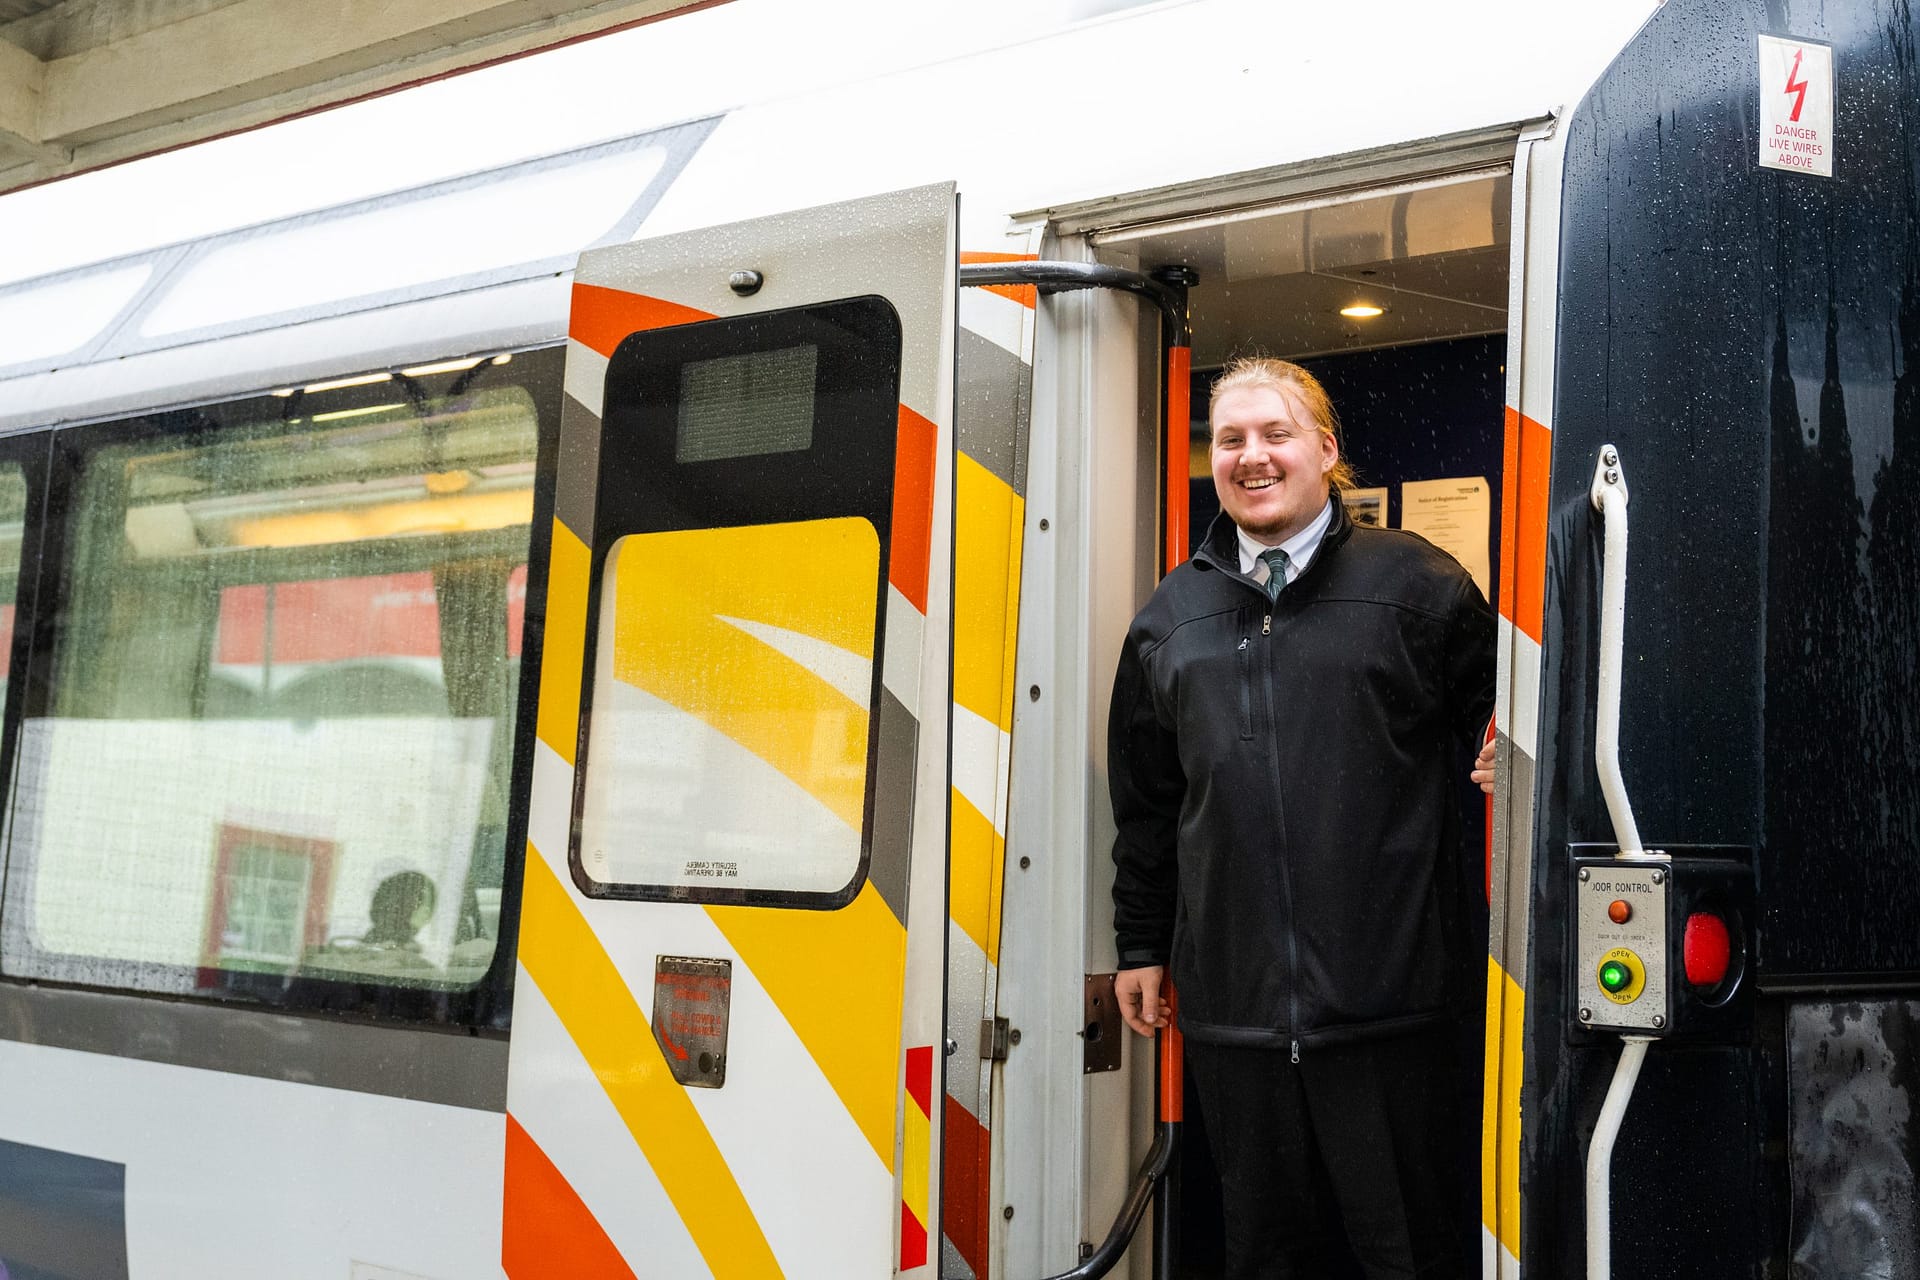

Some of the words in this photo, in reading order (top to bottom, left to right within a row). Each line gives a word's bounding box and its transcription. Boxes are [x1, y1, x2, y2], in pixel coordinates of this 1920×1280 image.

[1775, 124, 1817, 140] DANGER
[1769, 137, 1790, 150] LIVE
[1792, 141, 1823, 155] WIRES
[1778, 153, 1813, 168] ABOVE
[1615, 882, 1653, 893] CONTROL
[1611, 950, 1631, 958] OPEN
[1612, 993, 1632, 1001] OPEN
